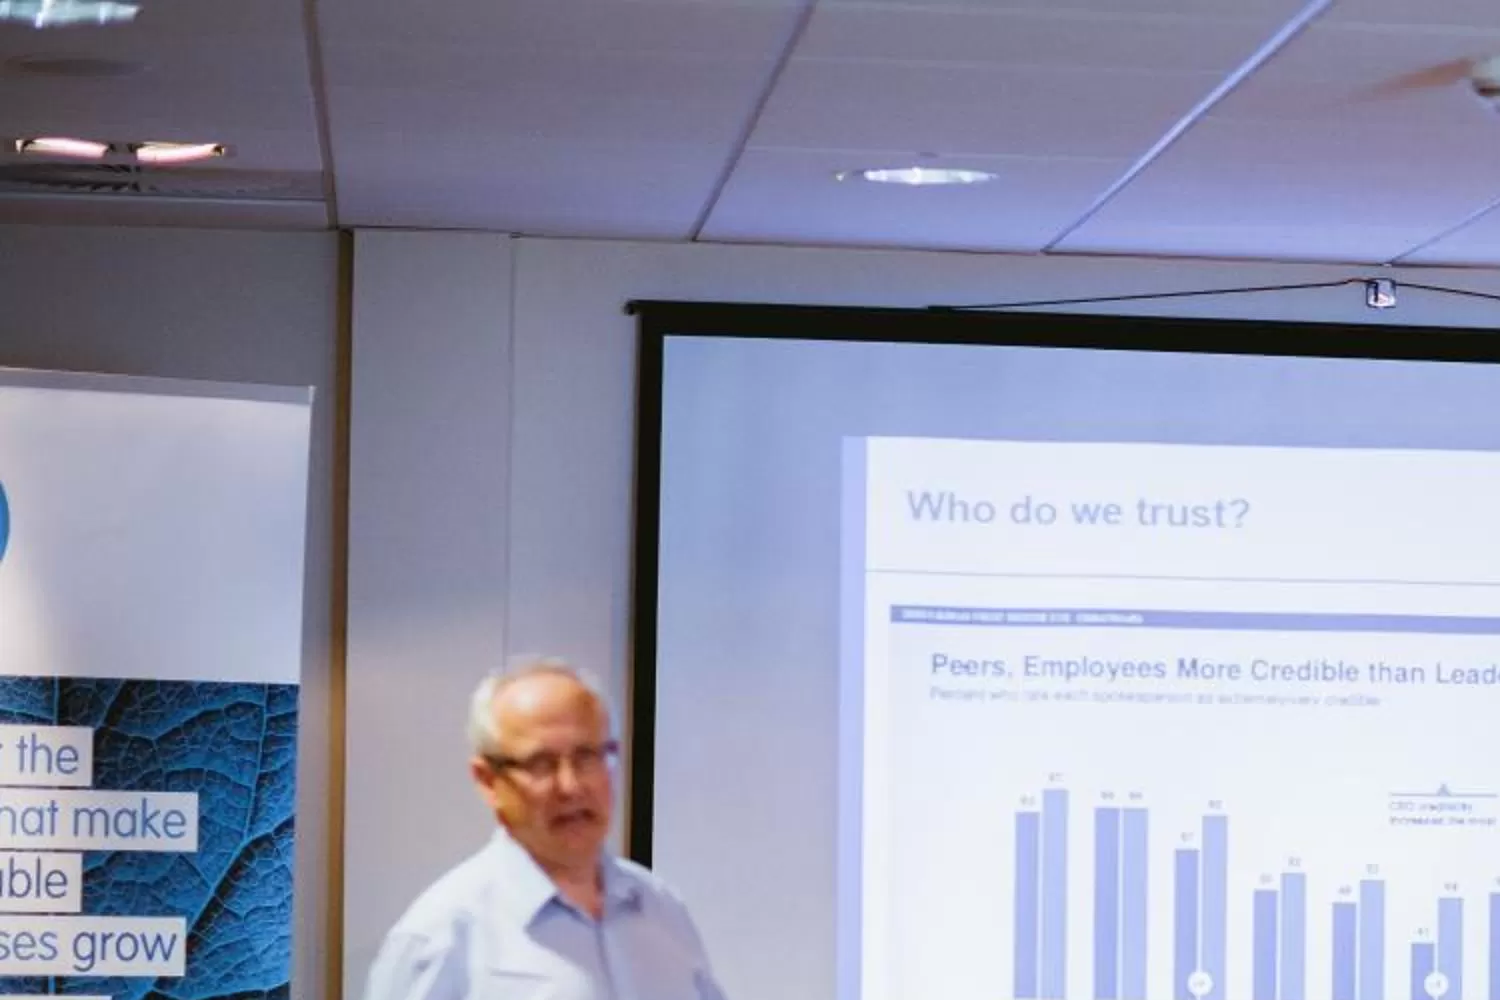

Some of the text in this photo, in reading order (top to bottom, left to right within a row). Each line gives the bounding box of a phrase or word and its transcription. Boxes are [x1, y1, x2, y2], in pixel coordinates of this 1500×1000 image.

[905, 488, 1252, 529] Who do we trust?
[931, 652, 1013, 680] Peers,
[1022, 654, 1169, 682] Employees
[1176, 656, 1243, 681] More
[1250, 658, 1361, 683] Credible
[1367, 660, 1426, 684] than
[16, 732, 80, 774] the
[73, 797, 187, 839] make
[0, 856, 67, 899] ble
[72, 931, 177, 972] grow
